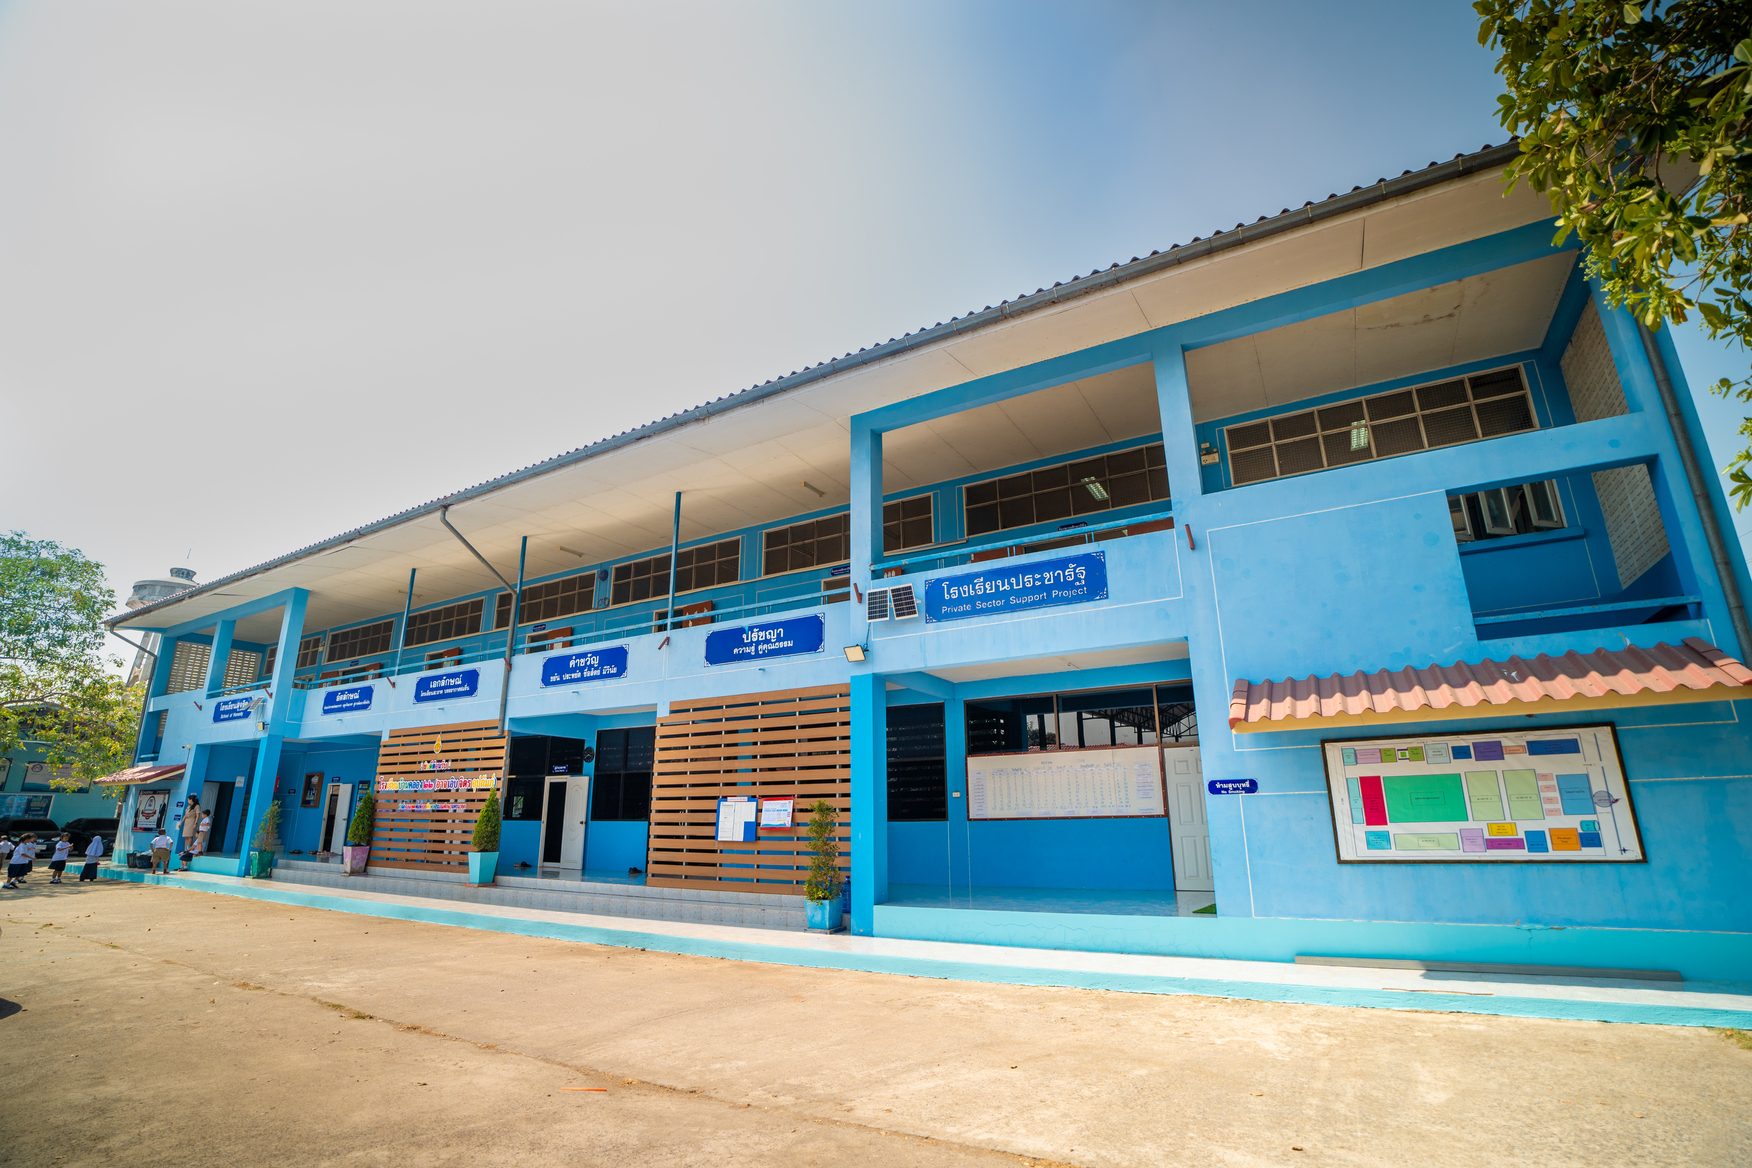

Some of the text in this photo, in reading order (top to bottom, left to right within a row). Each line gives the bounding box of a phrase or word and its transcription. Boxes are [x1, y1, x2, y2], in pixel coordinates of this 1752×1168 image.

[941, 563, 1086, 600] โรงเรียนประชารัฐ
[941, 587, 1088, 614] Private Sector Support Project
[742, 628, 784, 643] ปรัชญา
[733, 643, 755, 655] ความรู้
[569, 653, 599, 668] คำขวัญ
[430, 674, 463, 688] เอกลักษณ์
[1215, 780, 1250, 790] ห้ามสูบบุหรี่
